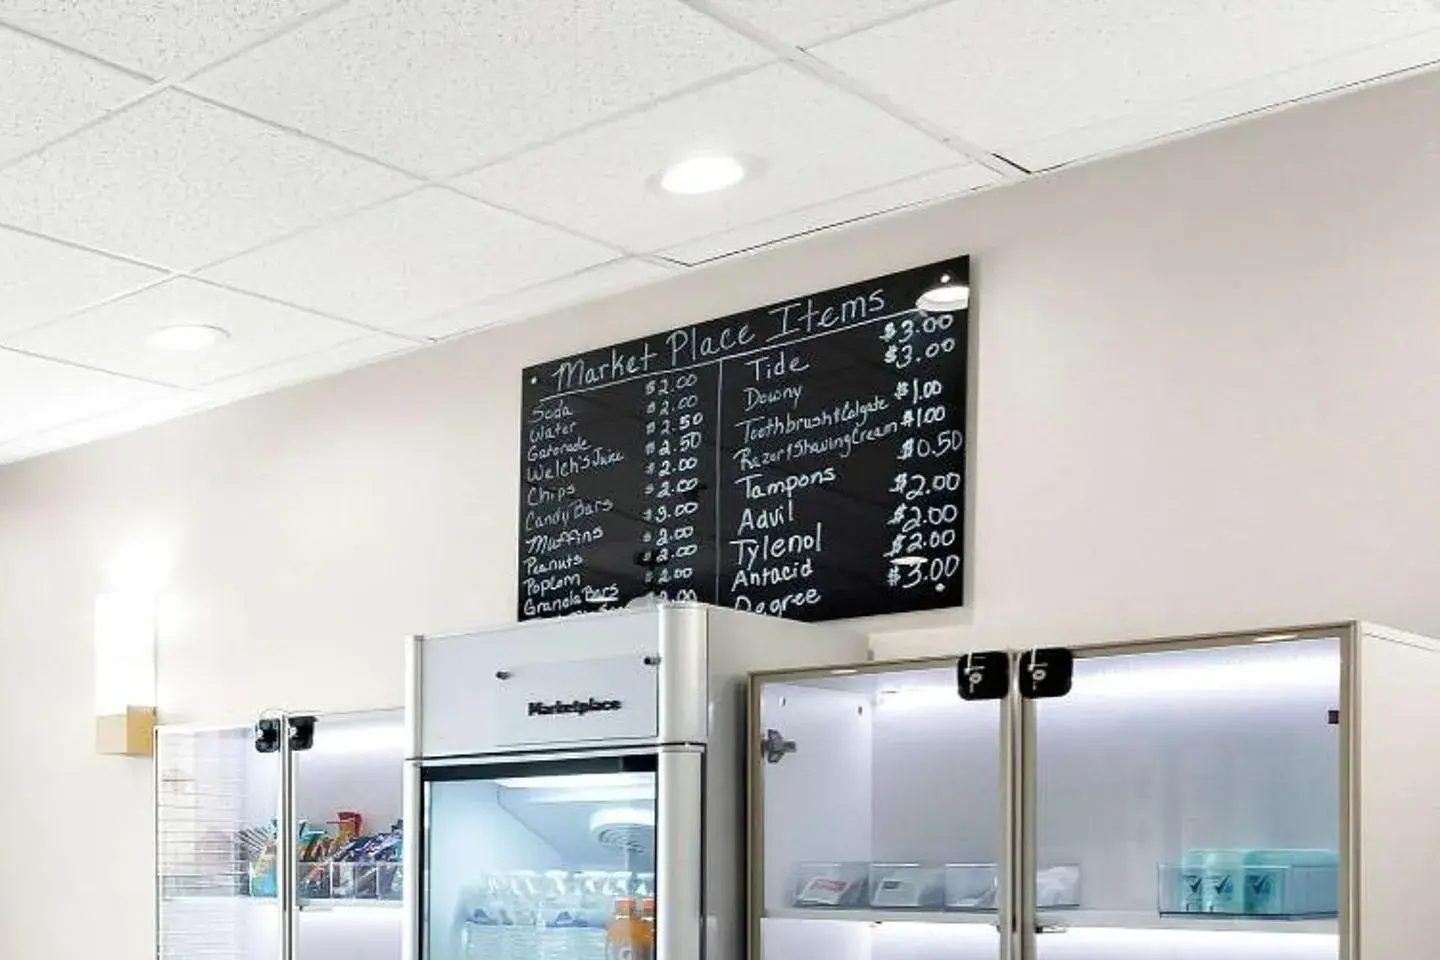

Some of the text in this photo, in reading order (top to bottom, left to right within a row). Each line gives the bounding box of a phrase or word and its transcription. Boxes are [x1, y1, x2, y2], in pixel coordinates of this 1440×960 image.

[552, 287, 885, 390] Market Place Items
[745, 314, 954, 381] Tide $3.00
[528, 374, 698, 423] Soda $2.00
[744, 338, 956, 412] Downy $3.00
[894, 379, 942, 404] $1.00
[527, 412, 704, 462] Gatorade $2.50
[529, 395, 698, 443] Water $2.00
[901, 406, 946, 428] $1.00
[644, 431, 702, 456] $2.50
[735, 430, 963, 499] Tampons $0.50
[527, 456, 698, 506] Chips $2.00
[644, 477, 698, 498] $2.00
[737, 472, 960, 536] Advil $2.00
[523, 525, 694, 575] Peanuts $2.00
[525, 525, 604, 554] Muffins
[642, 544, 698, 563] $2.00
[729, 503, 957, 571] Tylenol $2.00
[731, 529, 956, 592] Antacid $2.00
[523, 591, 582, 616] Granola
[734, 555, 960, 616] Degree $3.00
[527, 697, 622, 716] Marketplace
